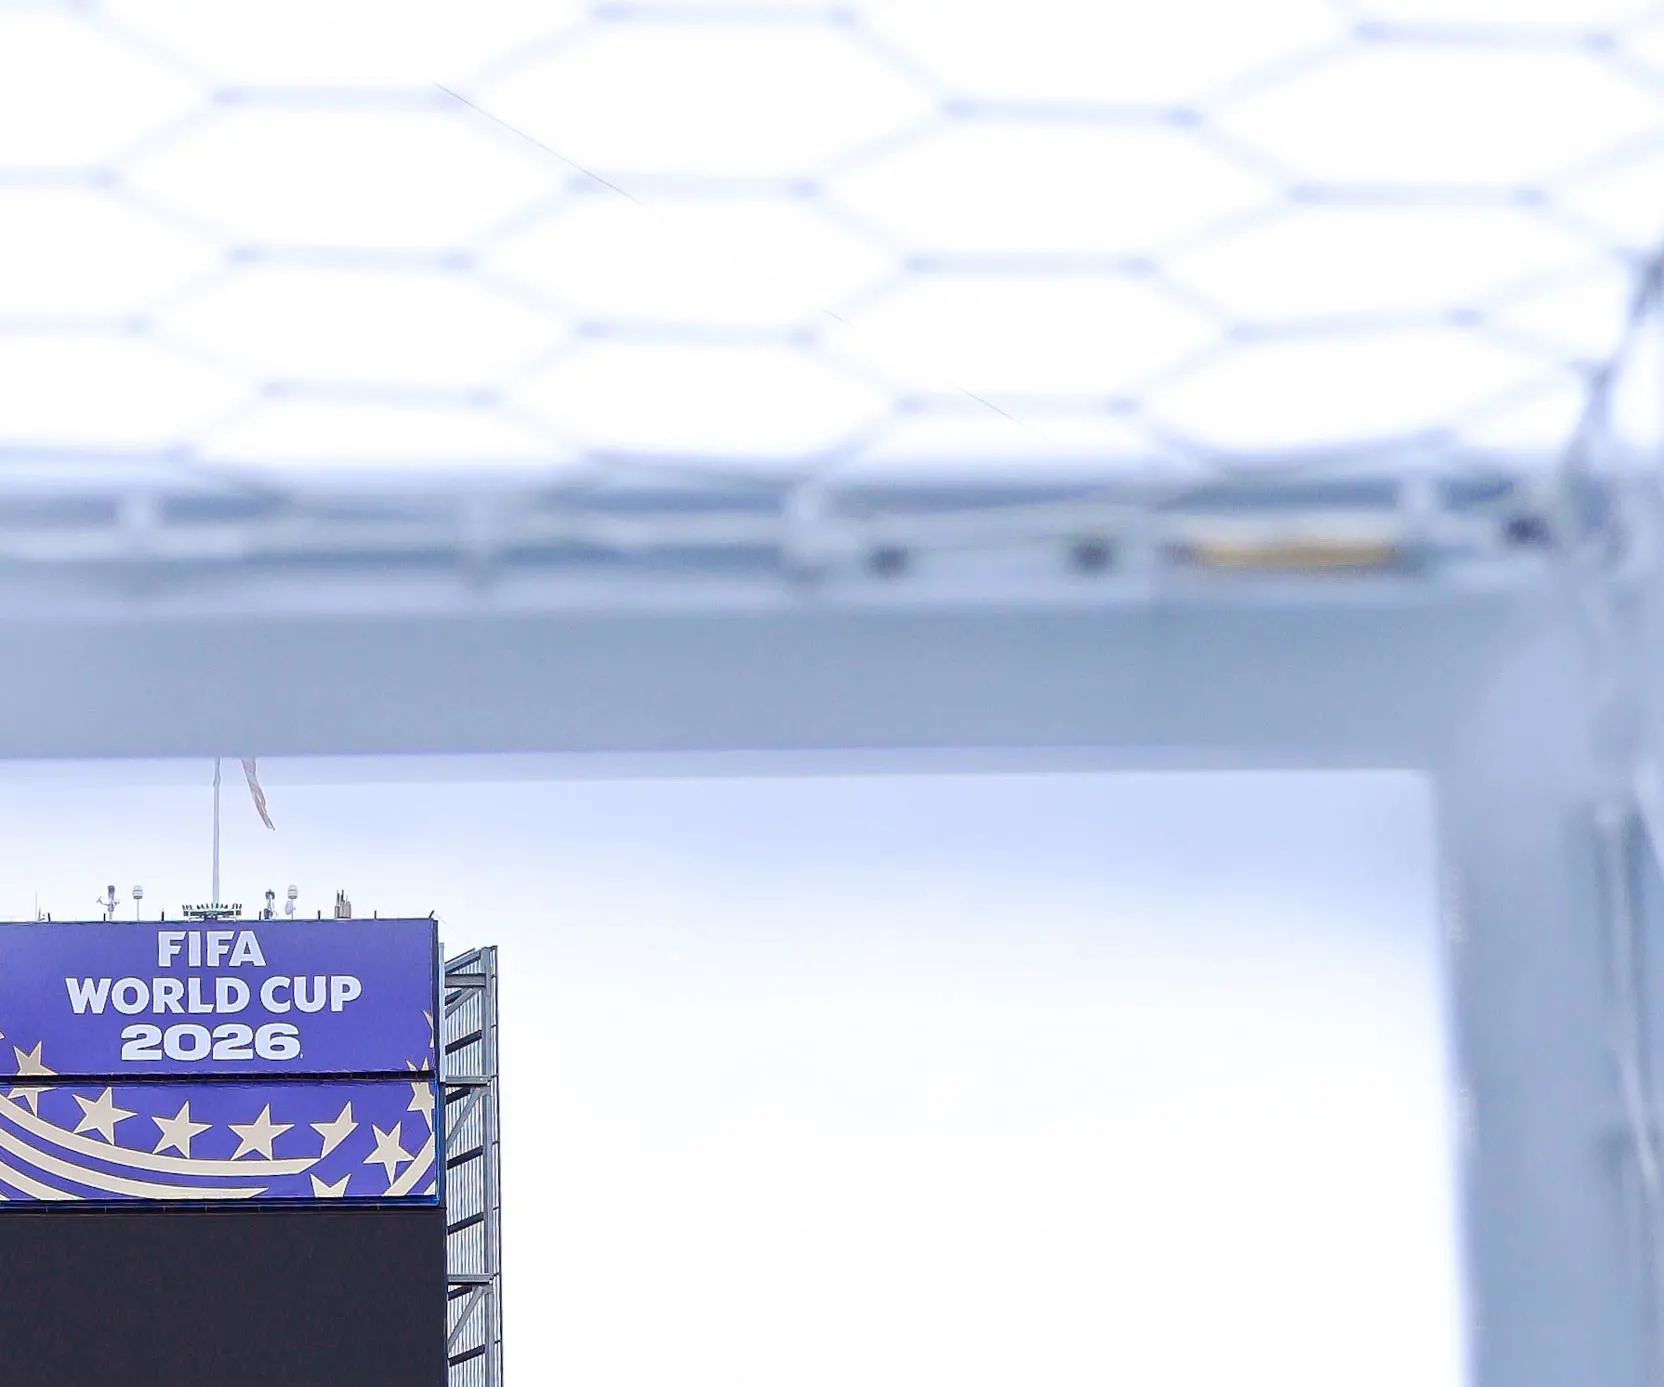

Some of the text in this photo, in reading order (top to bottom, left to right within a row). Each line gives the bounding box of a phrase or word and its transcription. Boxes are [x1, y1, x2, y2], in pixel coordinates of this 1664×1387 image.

[157, 931, 267, 968] FIFA
[65, 975, 362, 1014] WORLD CUP
[121, 1022, 301, 1061] 2026
